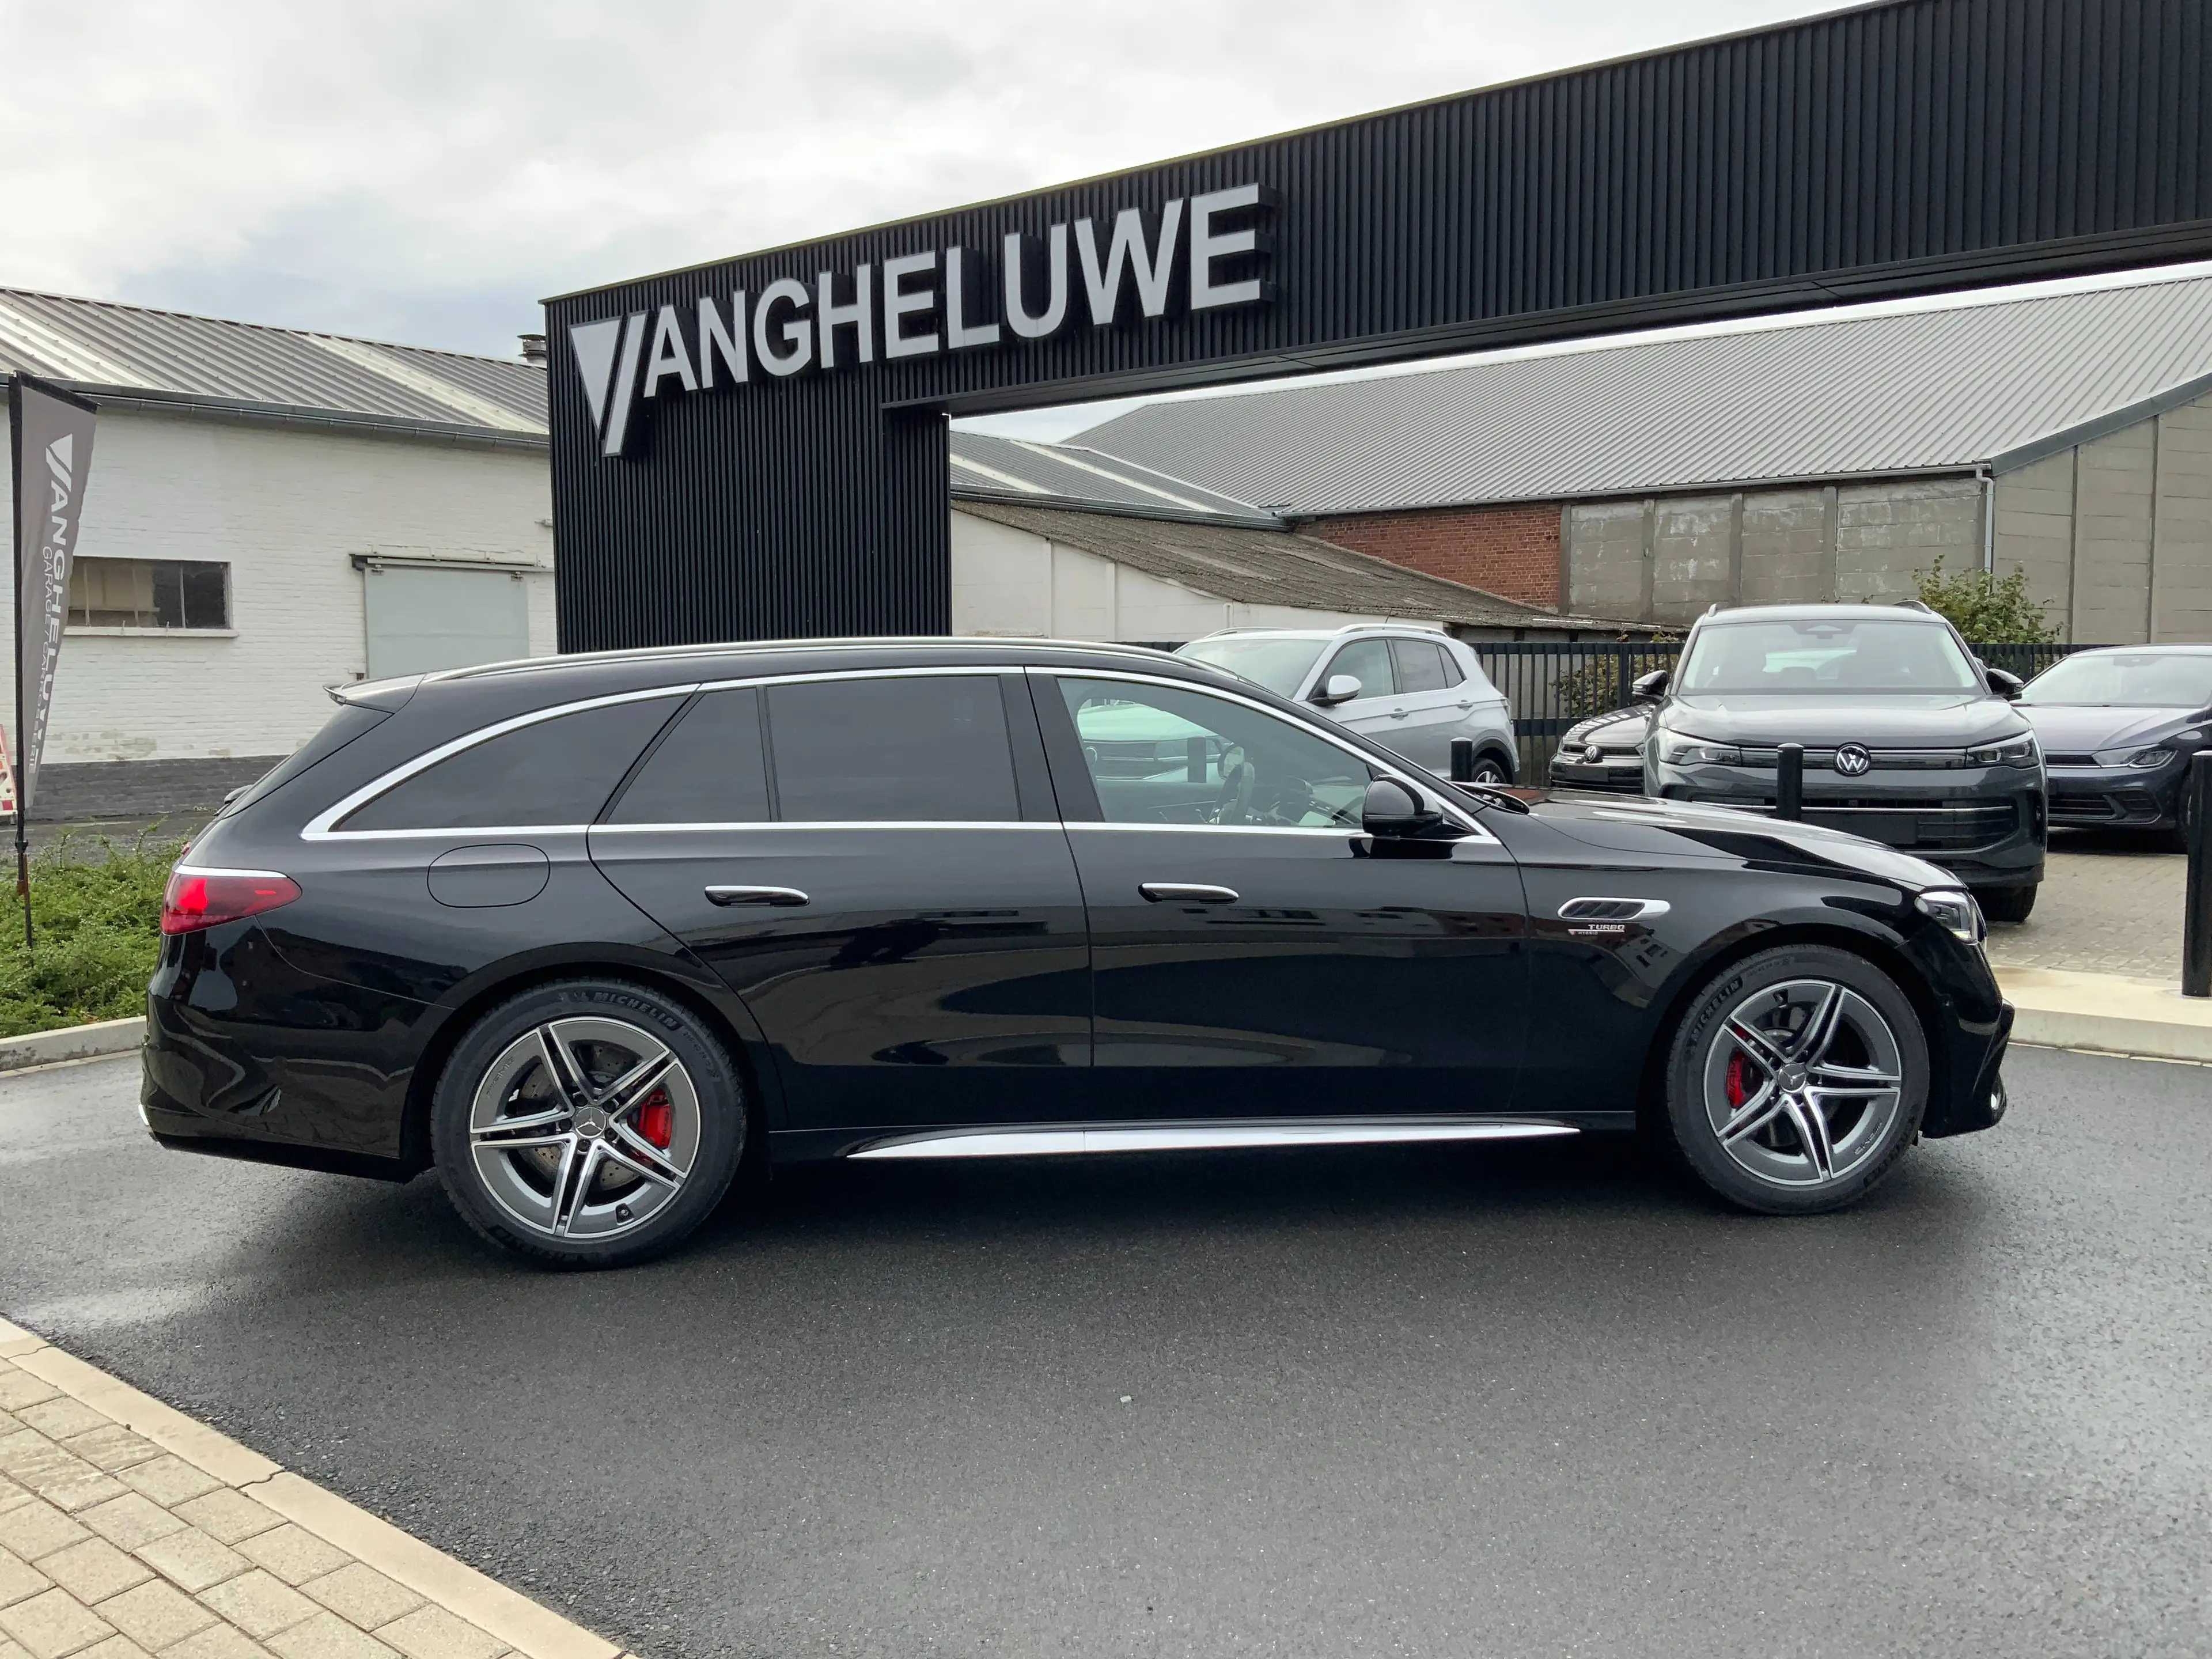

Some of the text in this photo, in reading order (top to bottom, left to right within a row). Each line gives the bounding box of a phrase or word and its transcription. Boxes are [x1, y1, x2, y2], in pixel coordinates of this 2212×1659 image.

[570, 182, 1262, 457] VANGHELUWE
[43, 546, 53, 624] GARAGE
[593, 991, 677, 1028] MICHELIN
